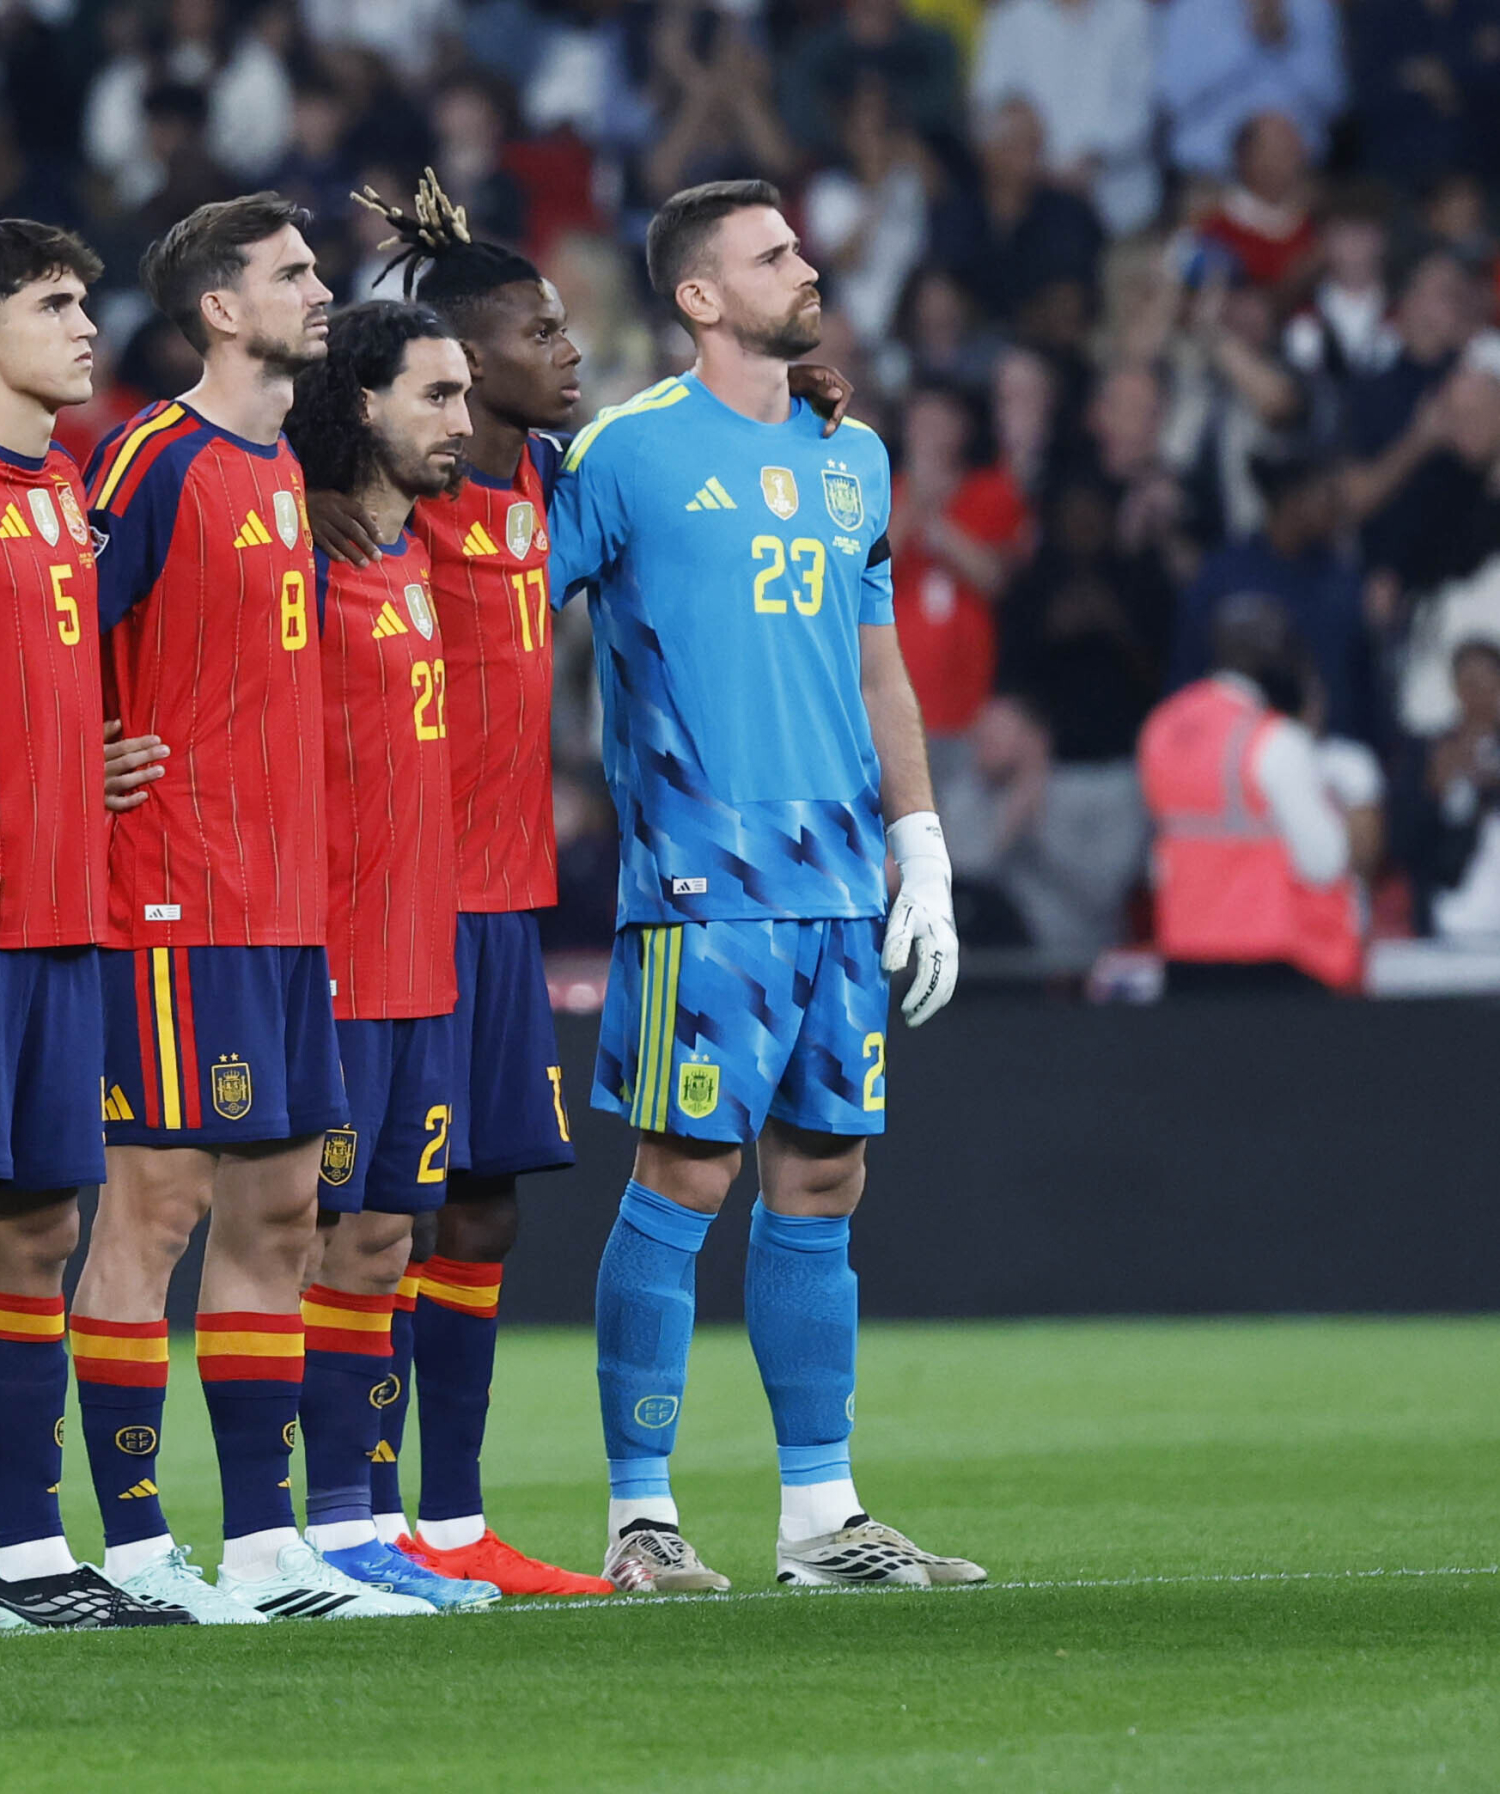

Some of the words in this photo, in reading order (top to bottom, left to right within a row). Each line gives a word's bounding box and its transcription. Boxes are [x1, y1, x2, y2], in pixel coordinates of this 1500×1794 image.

[49, 564, 80, 646] 5
[280, 570, 307, 651] 8
[511, 568, 546, 652] 17
[752, 535, 825, 617] 23
[411, 658, 446, 741] 22
[416, 1102, 453, 1184] 2
